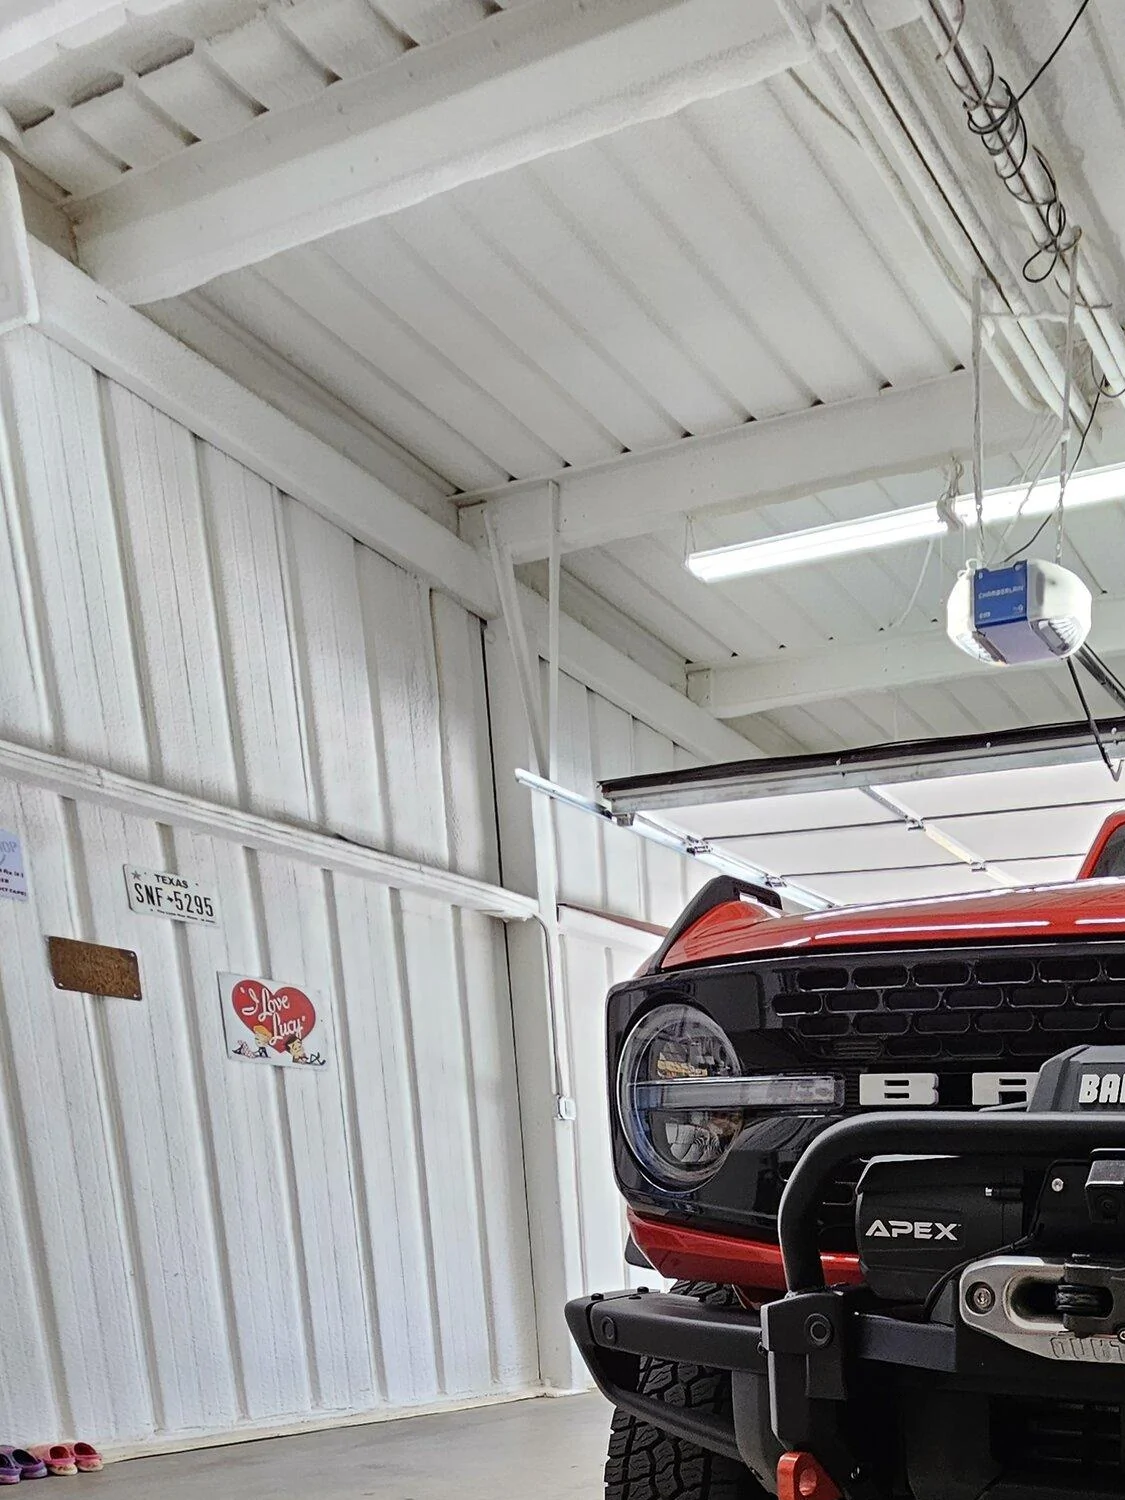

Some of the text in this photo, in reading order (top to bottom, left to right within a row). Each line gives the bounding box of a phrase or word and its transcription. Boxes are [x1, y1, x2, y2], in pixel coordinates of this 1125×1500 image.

[154, 873, 189, 889] TEXAS
[258, 988, 290, 1022] Love
[865, 1218, 961, 1241] APEX
